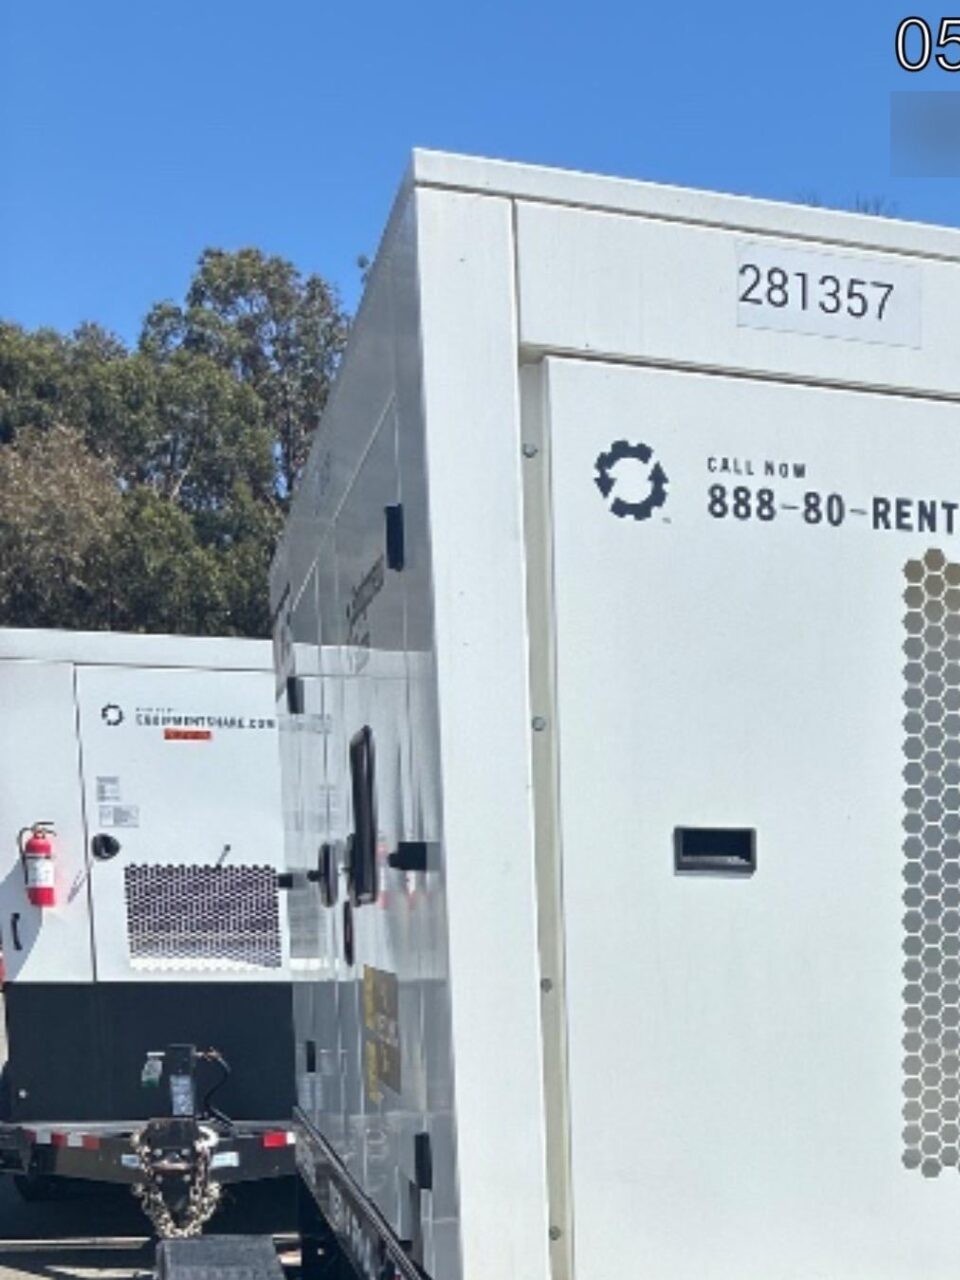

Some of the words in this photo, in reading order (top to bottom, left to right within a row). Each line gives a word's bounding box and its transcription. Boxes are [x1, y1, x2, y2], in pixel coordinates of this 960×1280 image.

[738, 263, 895, 321] 281357
[707, 456, 754, 475] CALL
[765, 460, 807, 478] NOW
